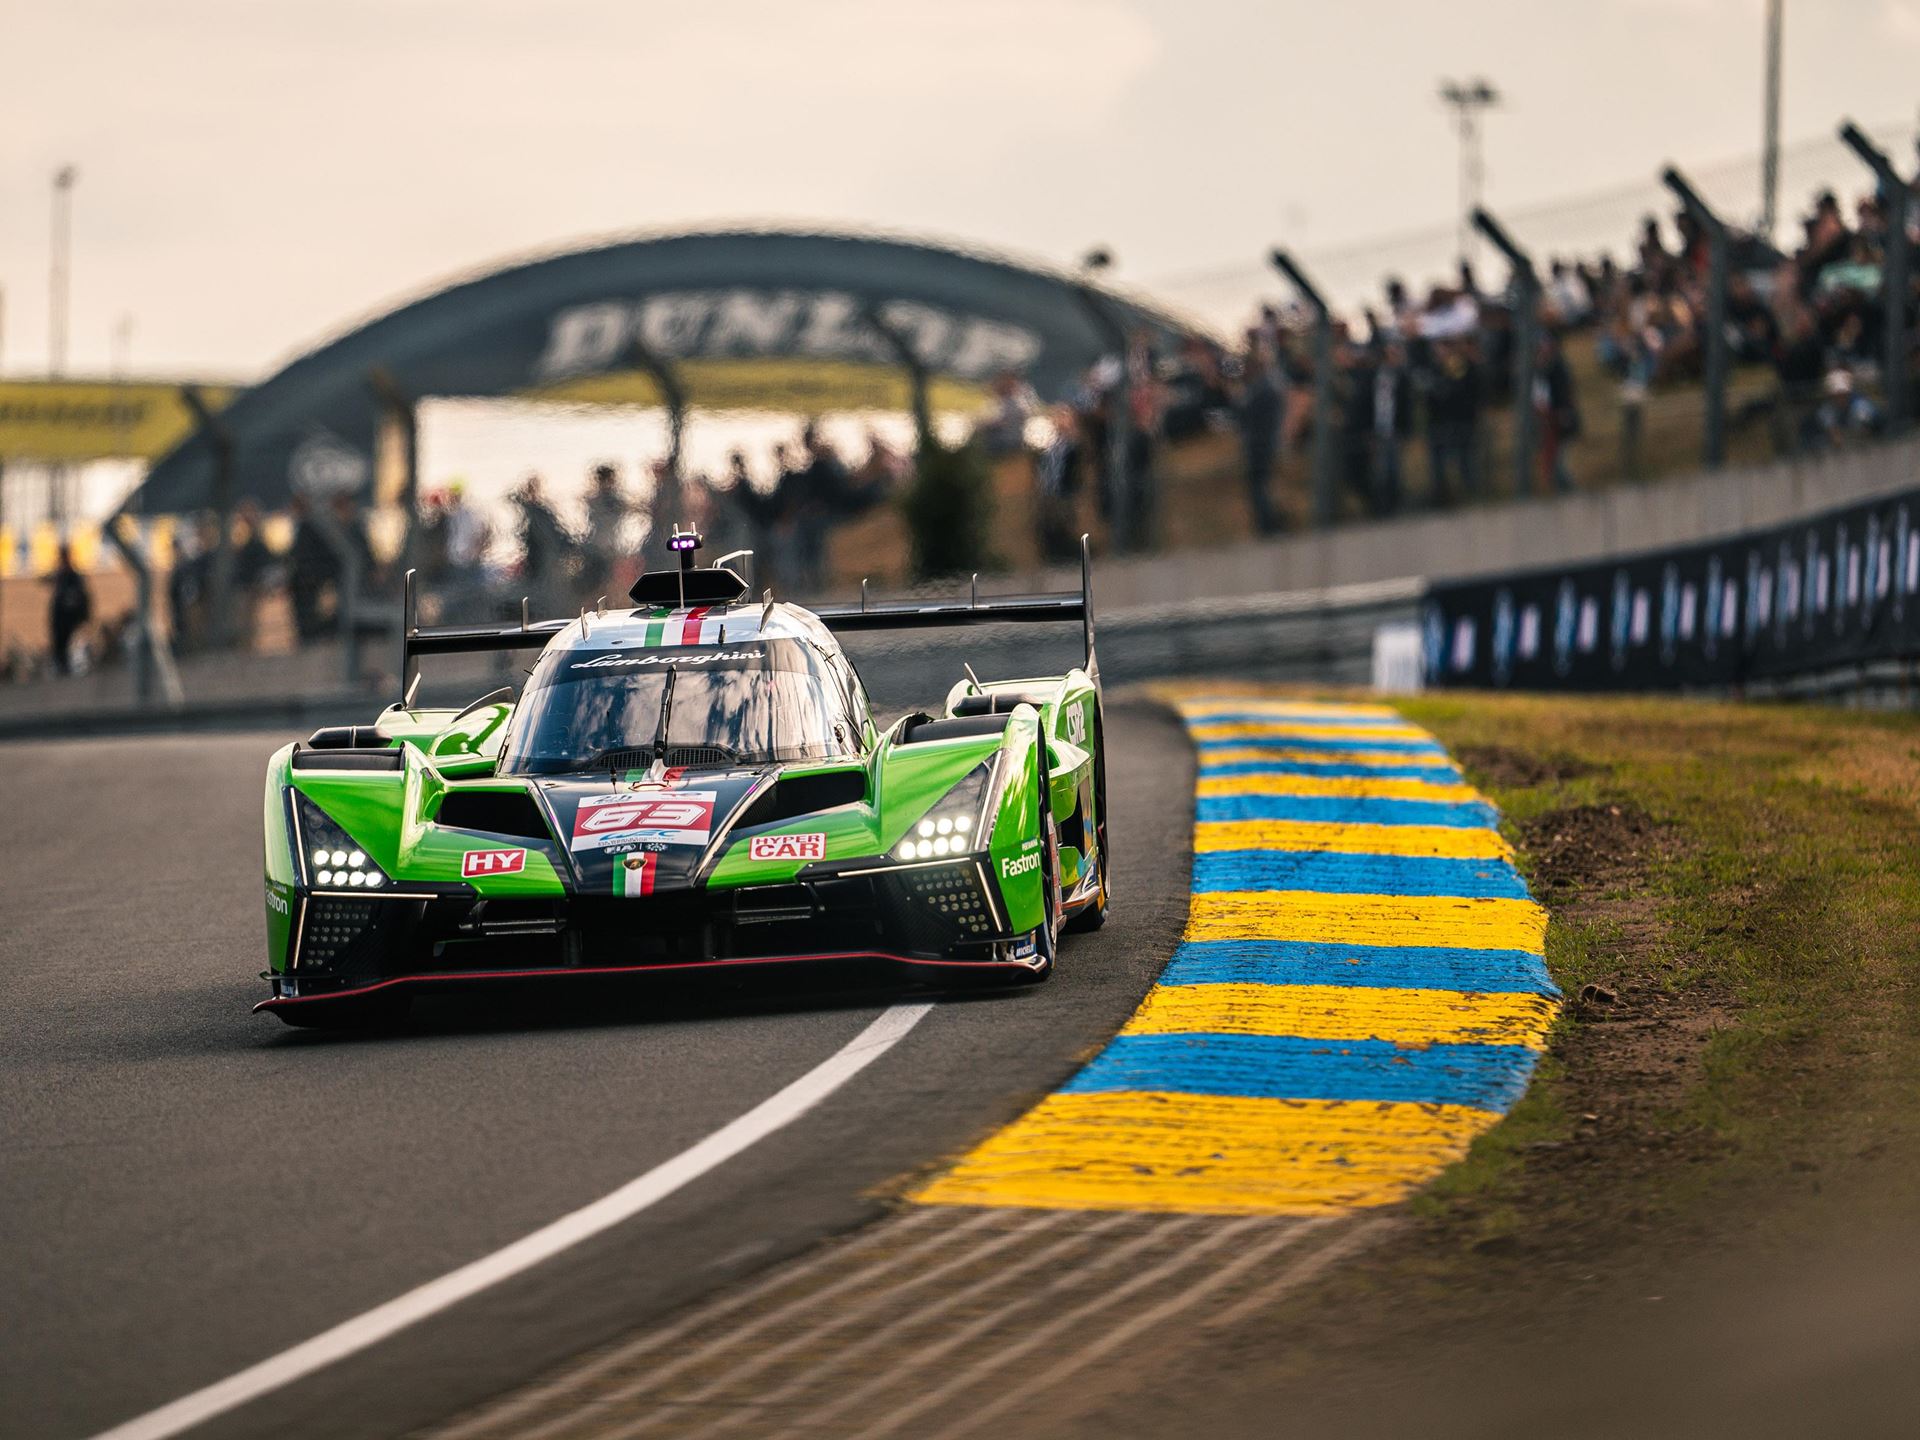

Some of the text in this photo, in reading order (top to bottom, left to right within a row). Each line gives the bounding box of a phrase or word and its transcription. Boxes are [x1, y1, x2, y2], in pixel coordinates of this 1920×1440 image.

[570, 650, 765, 669] Lamborghini
[581, 803, 706, 831] 63
[756, 835, 820, 844] HYPER
[755, 843, 819, 857] CAR
[468, 852, 521, 871] HY
[1001, 851, 1041, 879] Fastron
